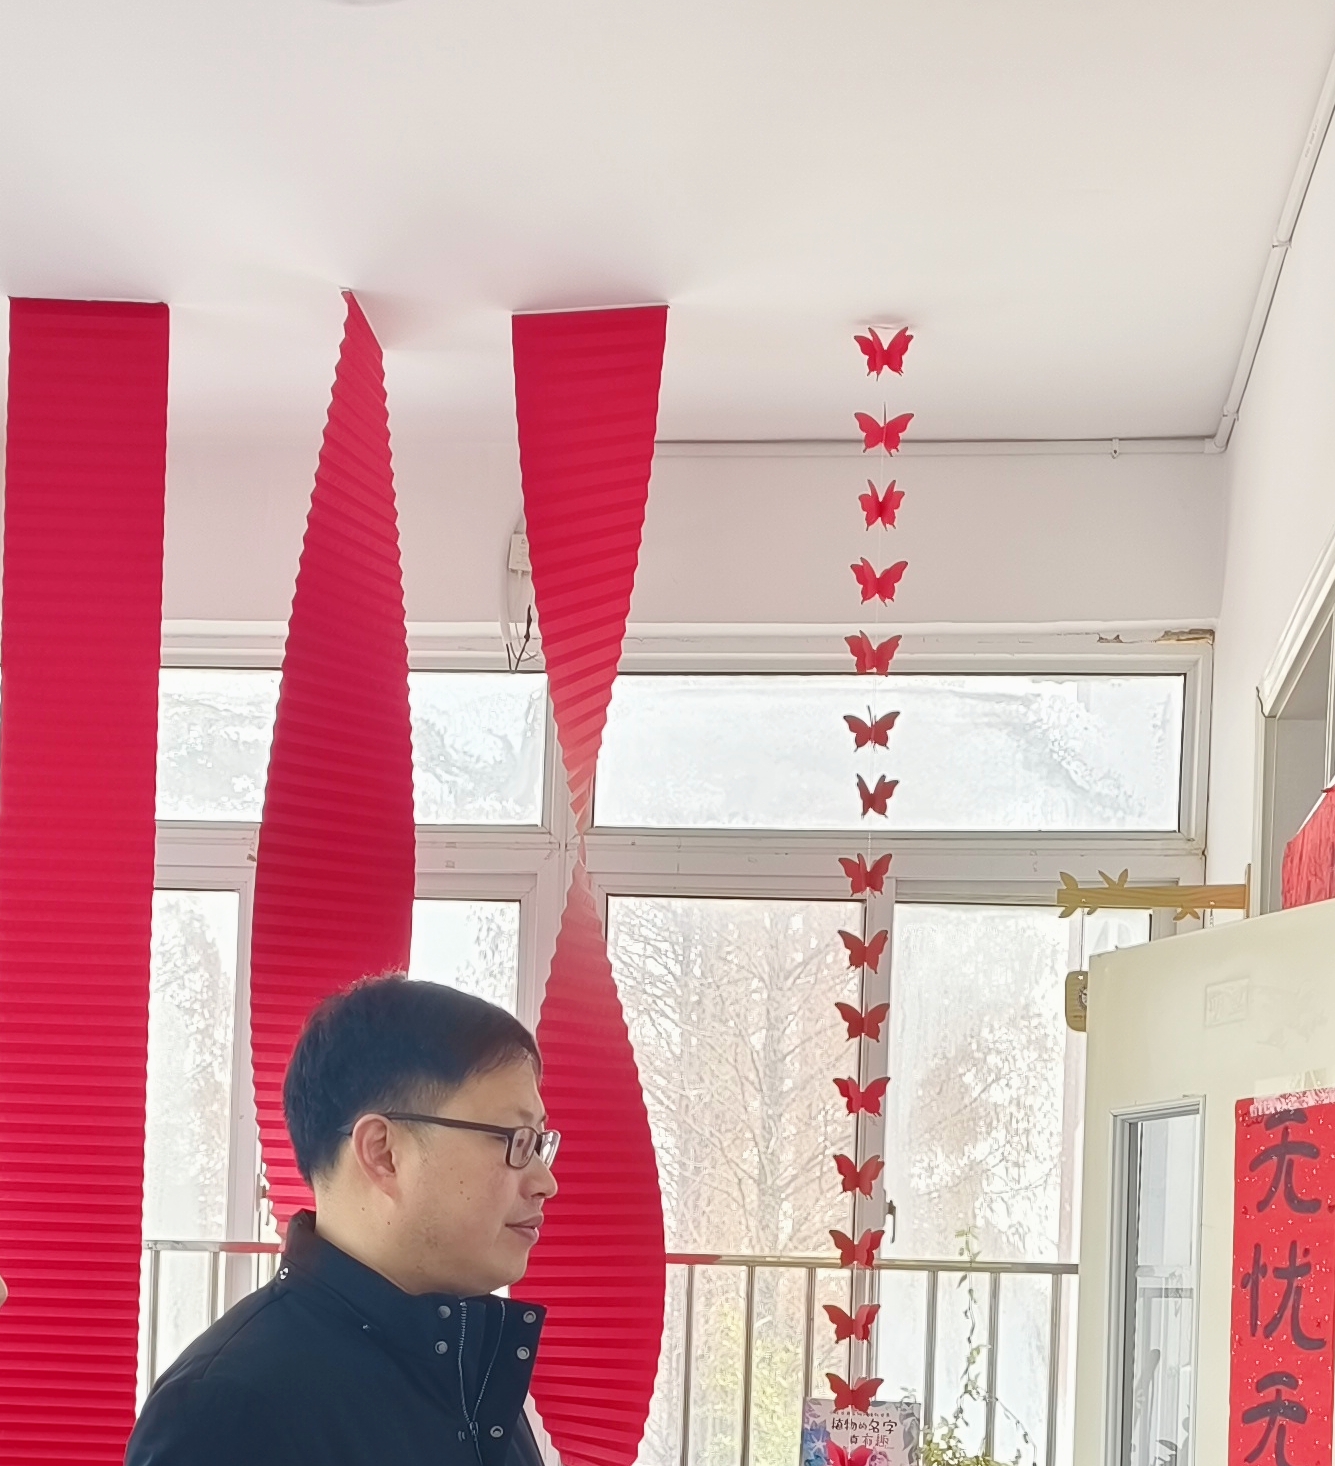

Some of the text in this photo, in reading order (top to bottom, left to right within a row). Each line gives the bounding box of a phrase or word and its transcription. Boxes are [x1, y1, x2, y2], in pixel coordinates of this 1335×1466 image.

[832, 1417, 897, 1435] 植物的名字
